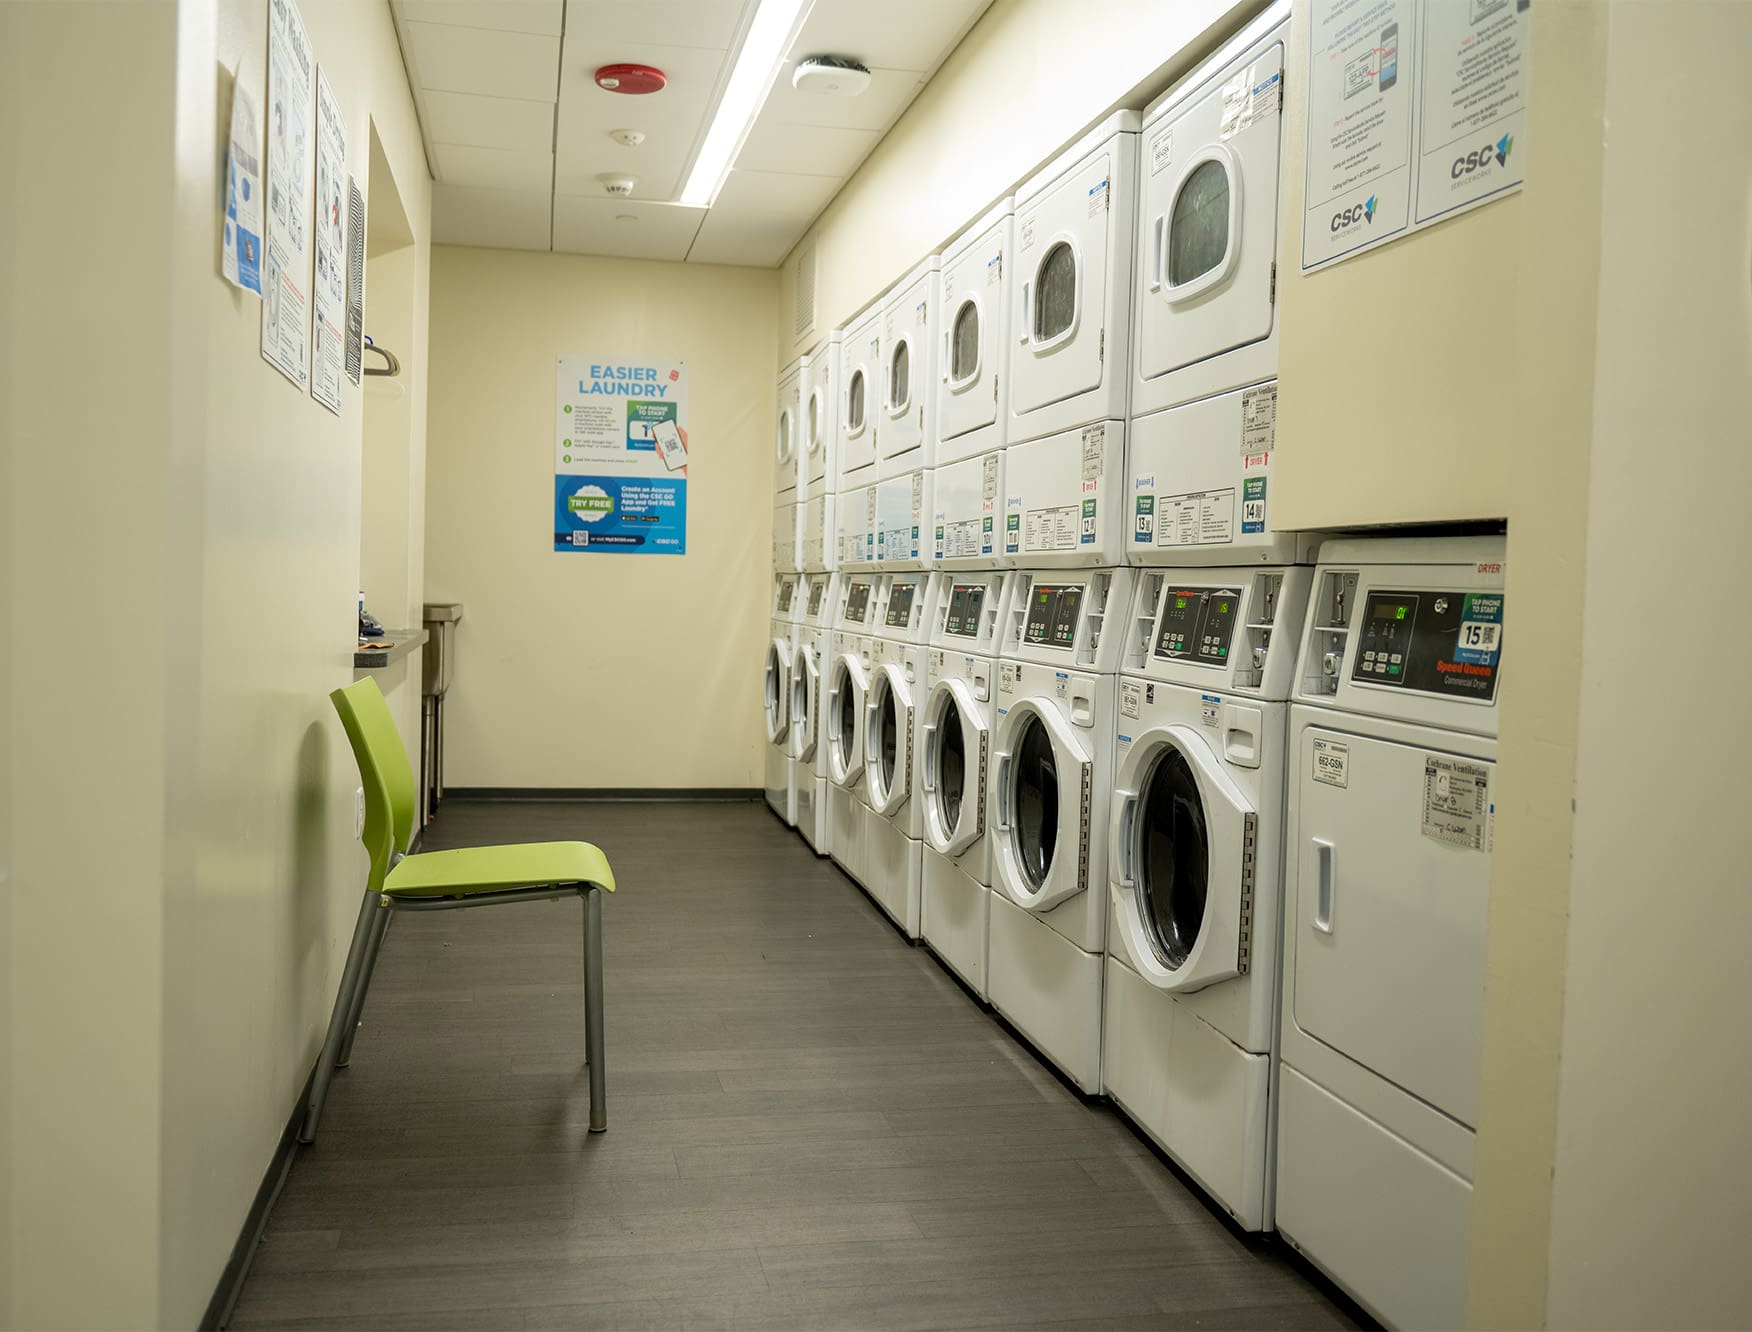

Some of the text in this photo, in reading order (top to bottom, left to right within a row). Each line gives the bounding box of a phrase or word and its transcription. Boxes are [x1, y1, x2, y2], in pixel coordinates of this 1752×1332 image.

[1451, 144, 1493, 179] CSC
[1331, 204, 1363, 232] CSC
[590, 365, 657, 381] EASIER
[578, 380, 668, 397] LAUNDRY
[1250, 457, 1262, 465] DRYER
[570, 499, 612, 509] TRY FREE
[1246, 504, 1255, 520] 14
[1084, 520, 1090, 532] 12
[1138, 516, 1146, 530] 13
[1478, 564, 1501, 574] DRYER
[1466, 625, 1482, 646] 15
[1437, 660, 1492, 676] Speed Queen
[1444, 676, 1488, 690] Commercial Dryer
[1318, 756, 1343, 770] 662-GSN
[1426, 757, 1486, 778] Cochrane Ventilation
